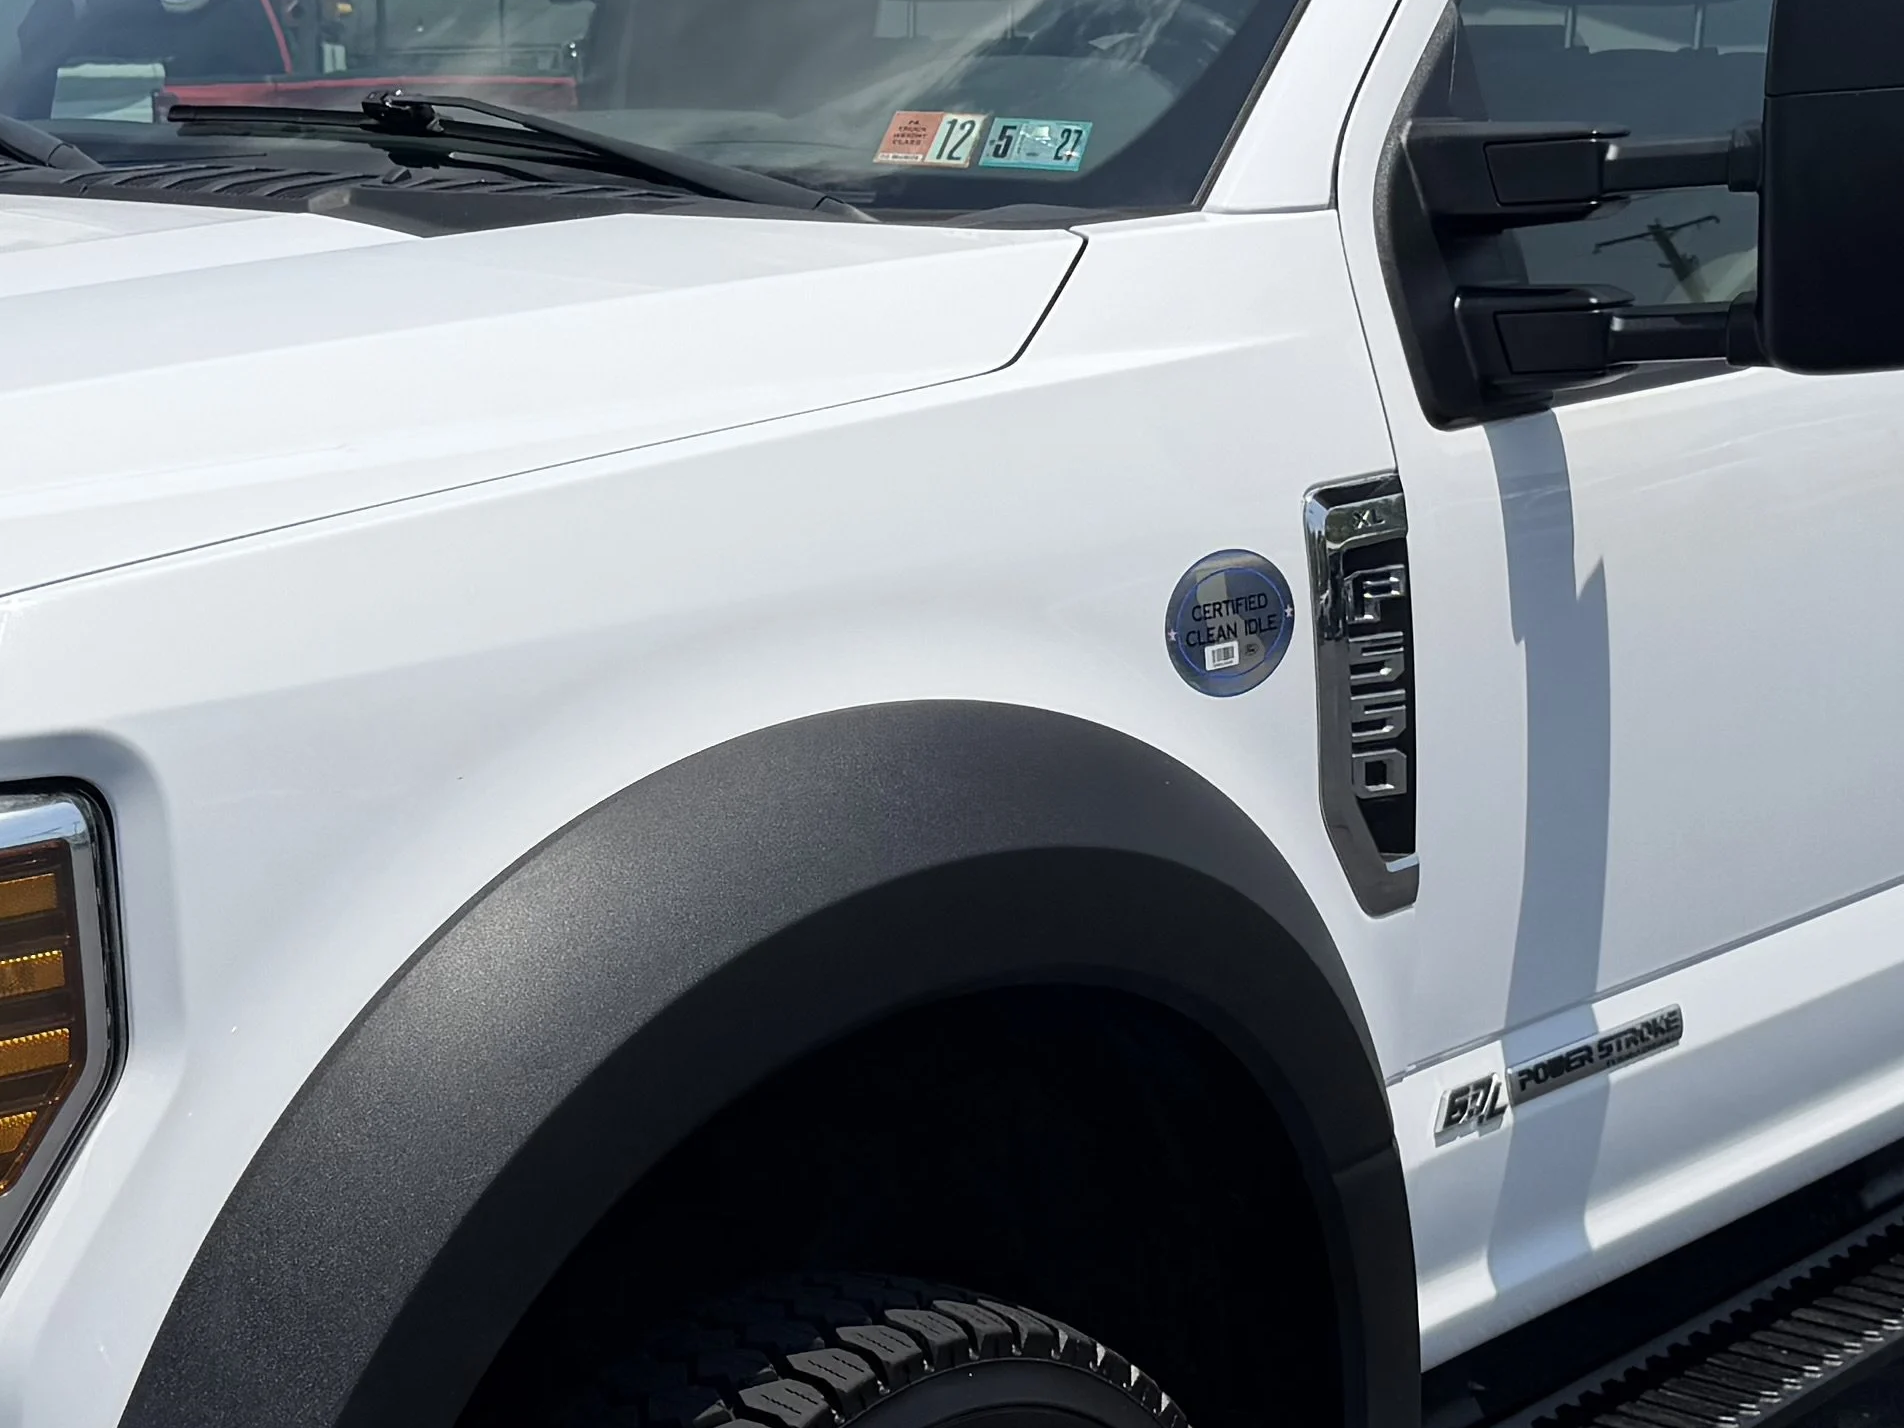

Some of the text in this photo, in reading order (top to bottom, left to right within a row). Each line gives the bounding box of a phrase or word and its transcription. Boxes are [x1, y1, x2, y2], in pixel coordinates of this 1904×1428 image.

[935, 118, 976, 161] 12
[992, 125, 1018, 159] 5
[1053, 128, 1084, 162] 27
[1353, 508, 1385, 529] XL
[1192, 592, 1268, 622] CERTIFIED
[1185, 614, 1278, 647] CLEAN IDLE
[1518, 1044, 1594, 1092] POWER
[1597, 1010, 1681, 1061] STROKE
